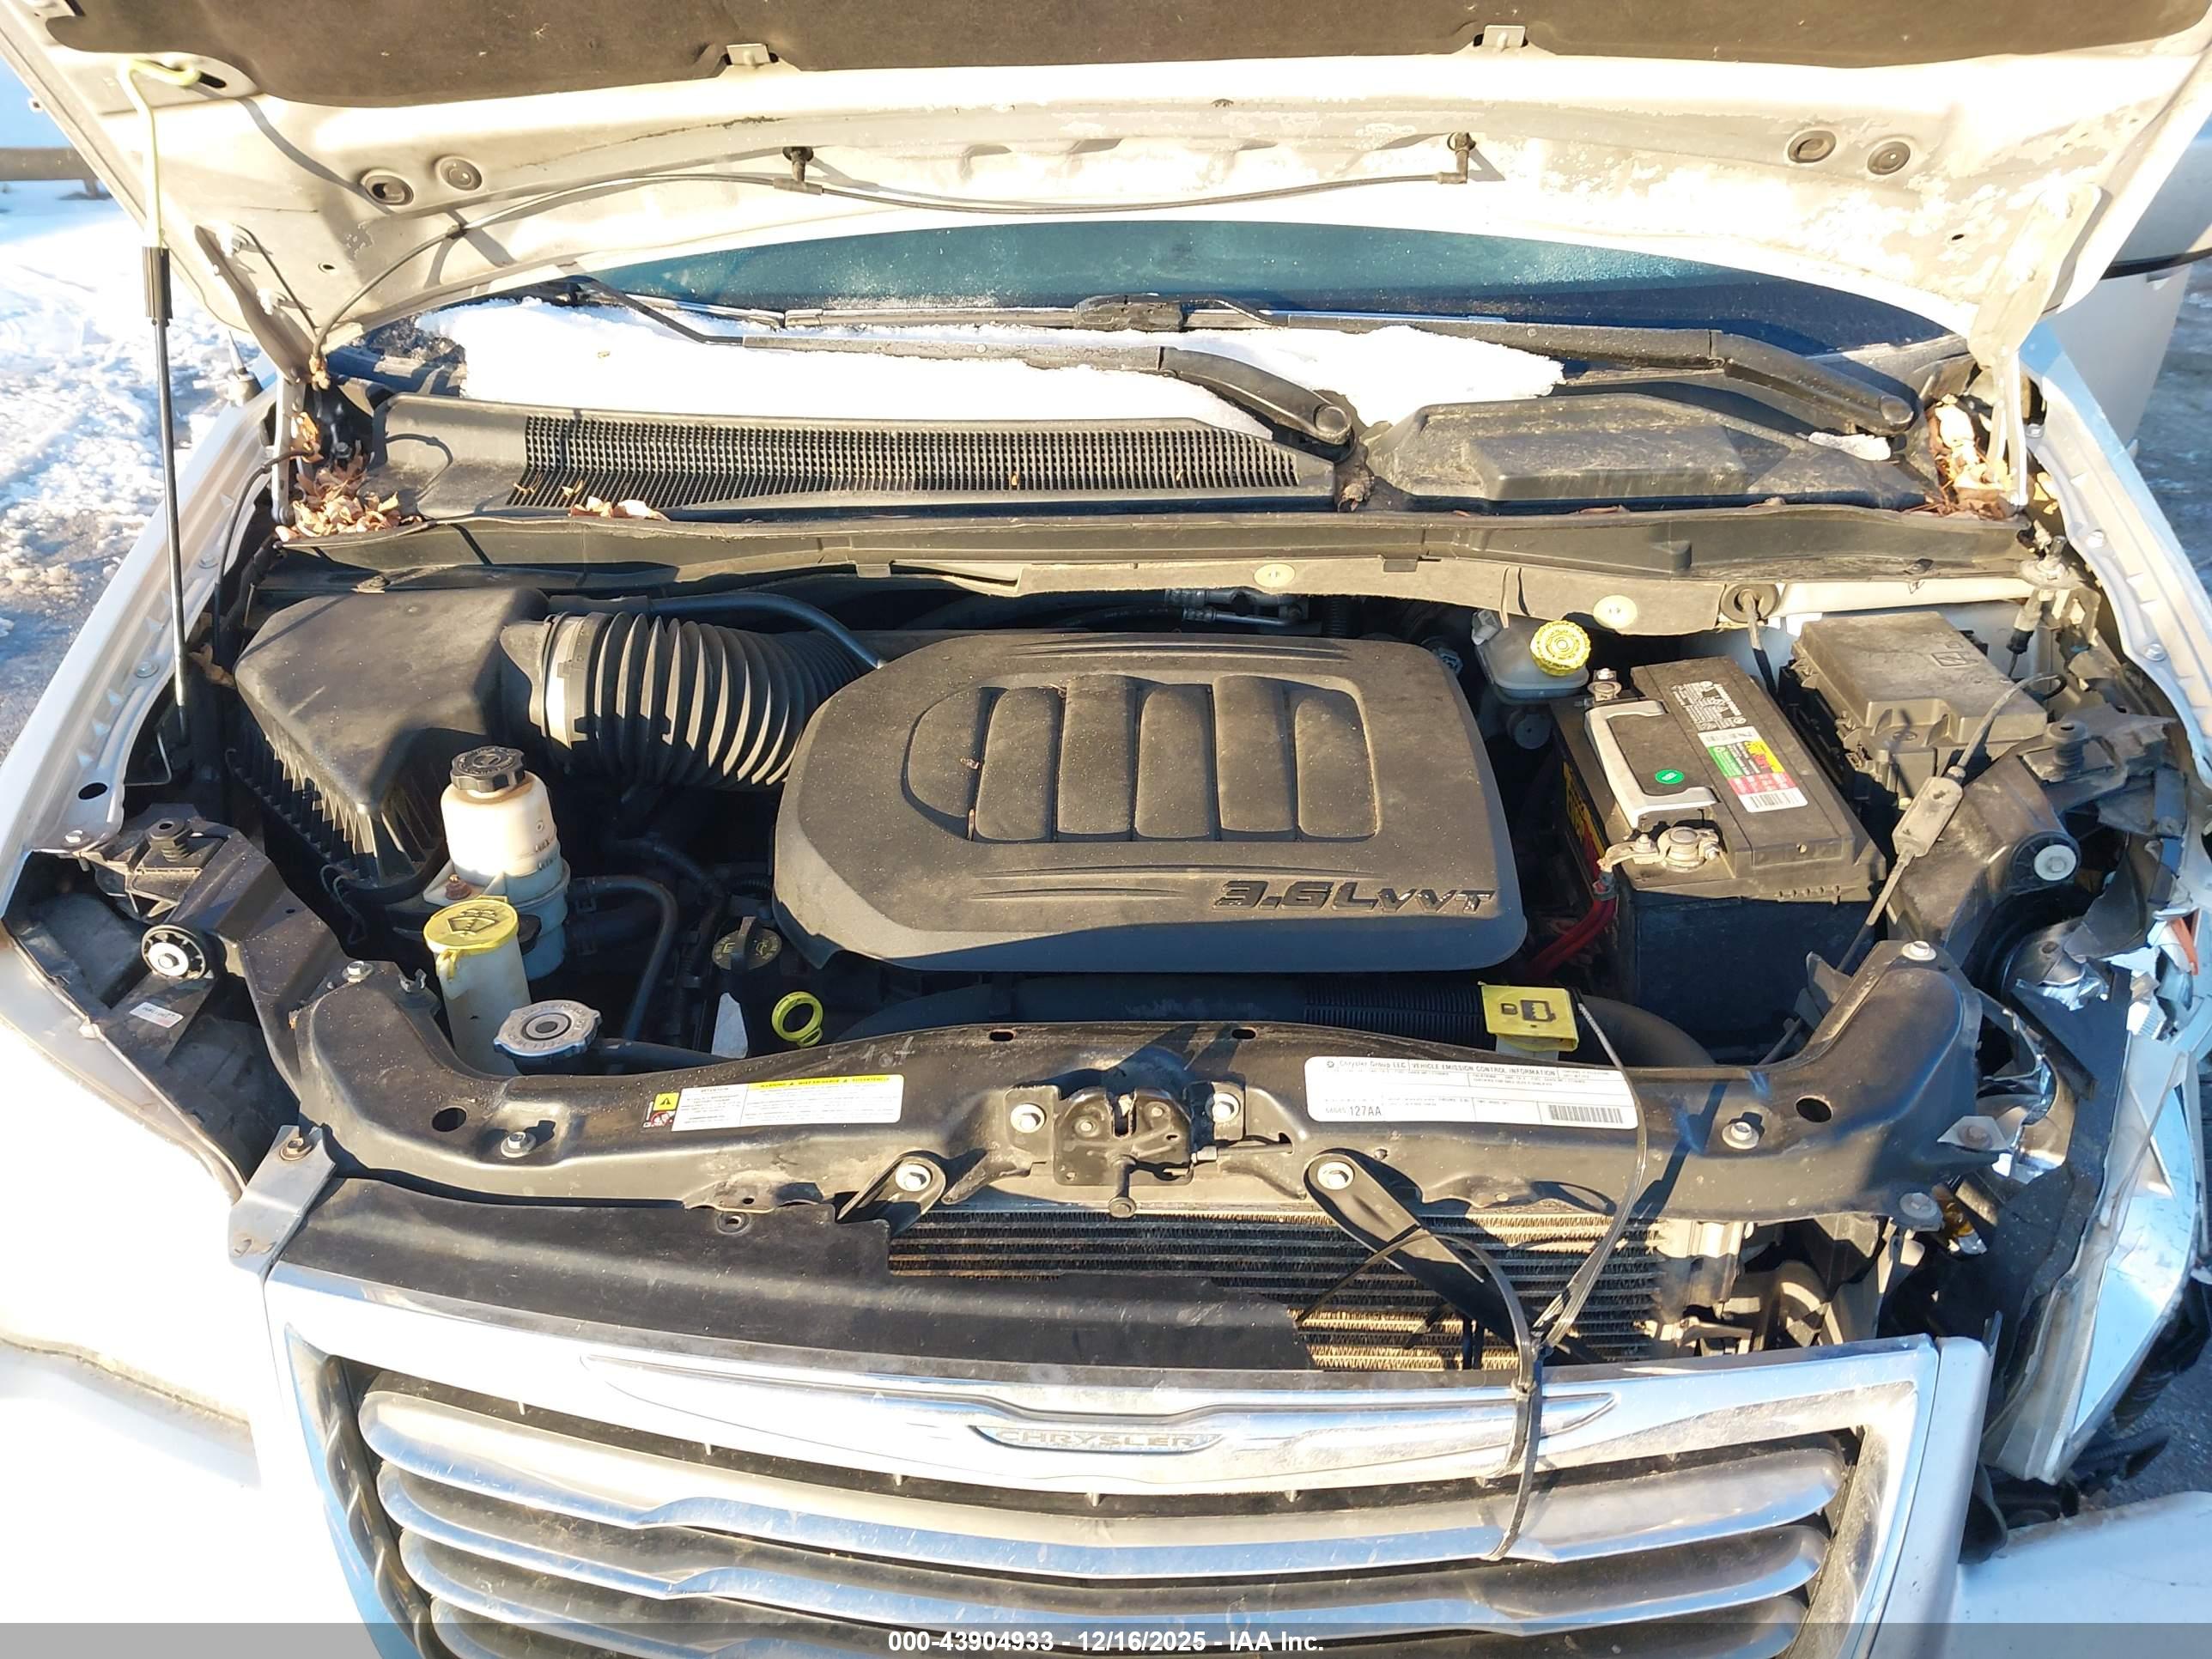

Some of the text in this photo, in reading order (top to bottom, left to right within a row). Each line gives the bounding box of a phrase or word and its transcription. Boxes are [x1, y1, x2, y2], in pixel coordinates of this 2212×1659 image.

[1442, 1064, 1474, 1073] EMISSION
[1476, 1066, 1505, 1074] CONTROL
[1509, 1068, 1557, 1077] INFORMATION
[1350, 1105, 1381, 1116] 127AA
[996, 1431, 1194, 1447] CHRYSLER
